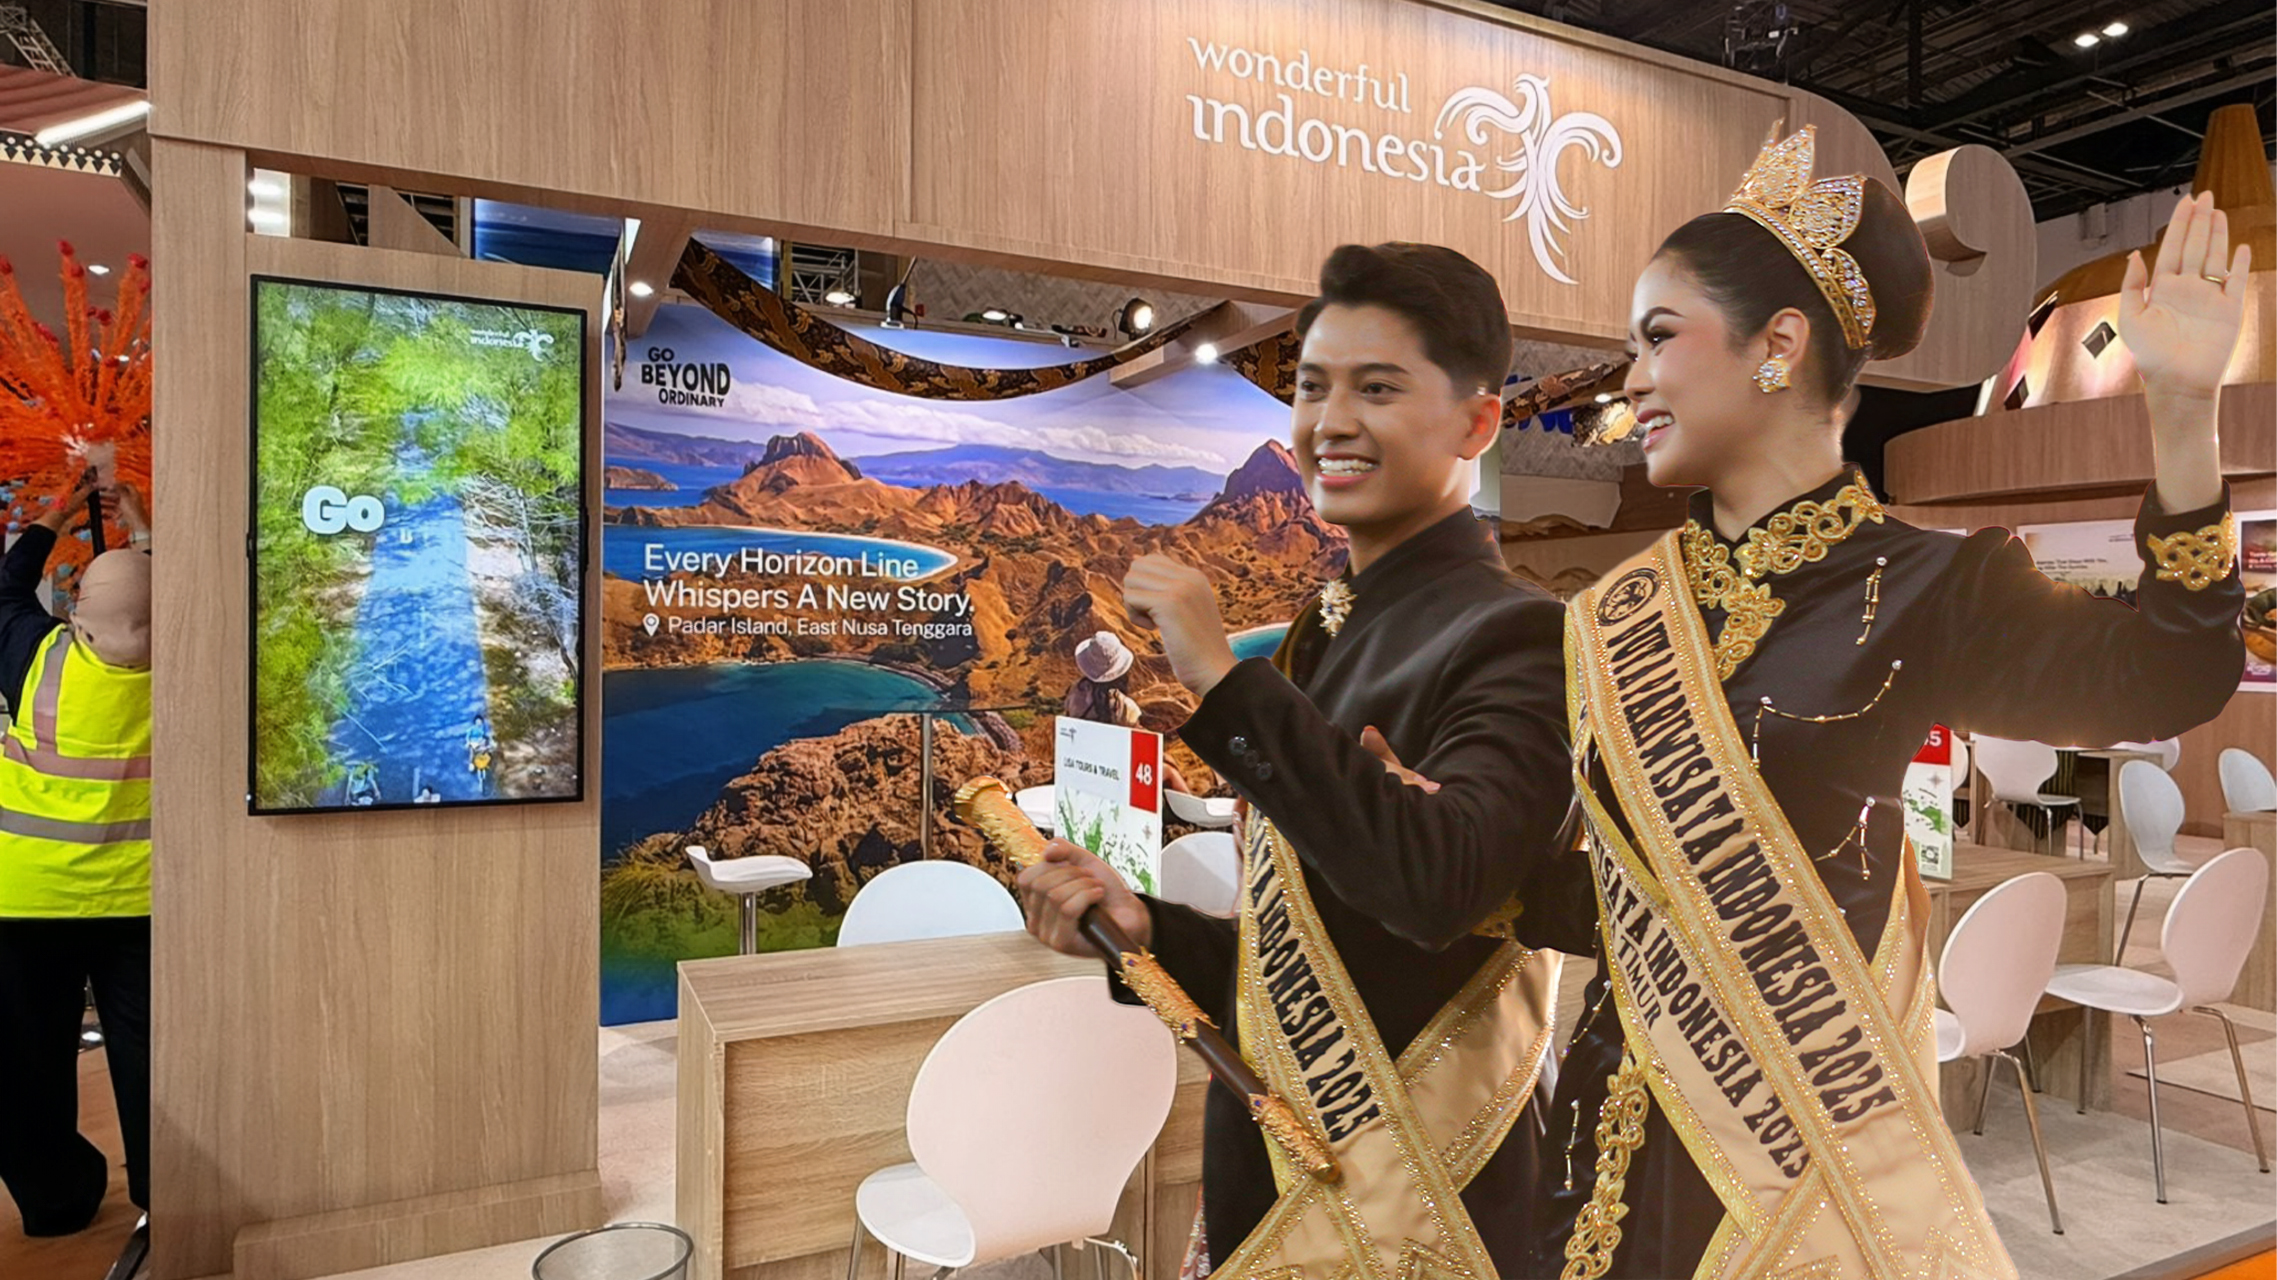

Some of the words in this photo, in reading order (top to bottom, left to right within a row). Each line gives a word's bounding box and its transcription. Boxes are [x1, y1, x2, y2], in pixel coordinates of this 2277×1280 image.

[1187, 37, 1411, 114] wonderful
[1186, 93, 1486, 193] indonesia
[648, 346, 675, 362] GO
[641, 363, 731, 396] BEYOND
[659, 388, 724, 408] ORDINARY
[302, 485, 385, 534] Go
[644, 543, 732, 577] Every
[741, 547, 852, 577] Horizon
[861, 551, 919, 578] Line
[644, 580, 789, 613] Whispers
[796, 584, 819, 610] A
[827, 585, 890, 611] New
[897, 586, 975, 616] Story.
[668, 616, 727, 635] Padar
[731, 616, 792, 637] Island,
[798, 618, 836, 636] East
[842, 619, 888, 636] Nusa
[892, 618, 972, 640] Tenggara
[1924, 730, 1942, 747] 5
[1135, 762, 1153, 787] 48
[1620, 667, 1744, 865] PARIWISATA
[1698, 841, 1847, 1046] INDONESIA
[1798, 1024, 1897, 1123] 2025
[1618, 935, 1661, 1030] TIMUR
[1256, 888, 1346, 1073] INDONESIA
[1306, 1047, 1381, 1143] 2025
[1644, 927, 1763, 1108] INDONESIA
